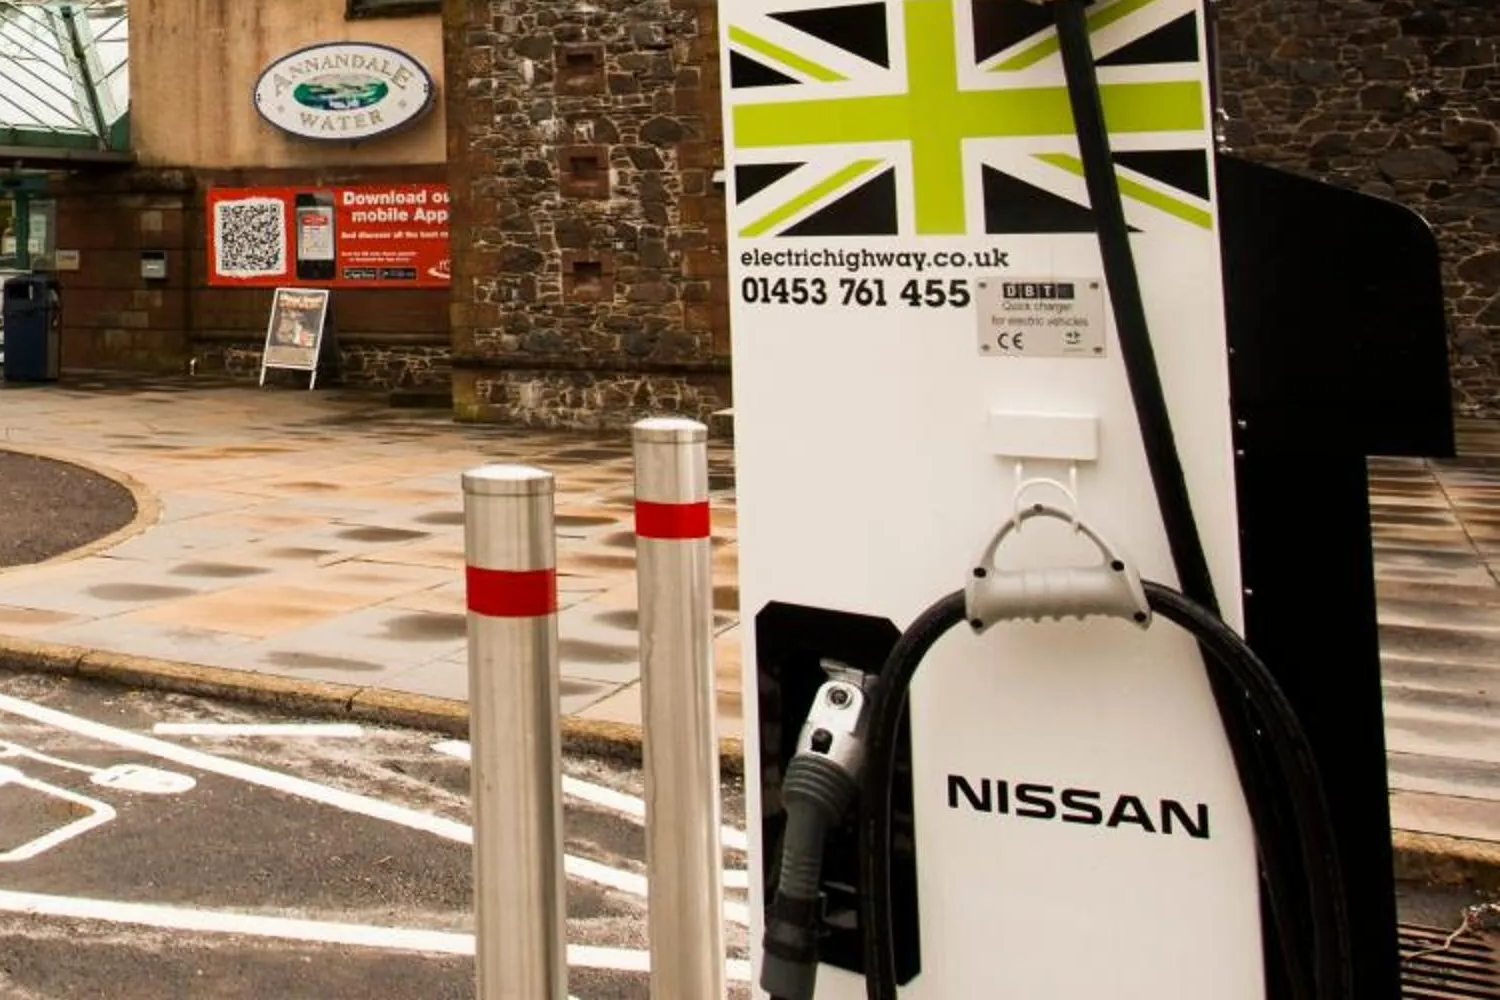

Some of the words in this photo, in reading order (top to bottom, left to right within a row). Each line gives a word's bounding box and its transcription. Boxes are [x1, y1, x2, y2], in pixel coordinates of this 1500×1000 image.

[272, 54, 413, 97] ANNANDALE
[300, 110, 384, 132] WATER
[343, 190, 427, 205] Download
[351, 207, 409, 222] mobile
[740, 248, 1010, 271] electrichighway.co.uk
[741, 277, 829, 305] 01453
[839, 278, 887, 307] 761
[900, 279, 972, 308] 455
[947, 774, 1211, 840] NISSAN
